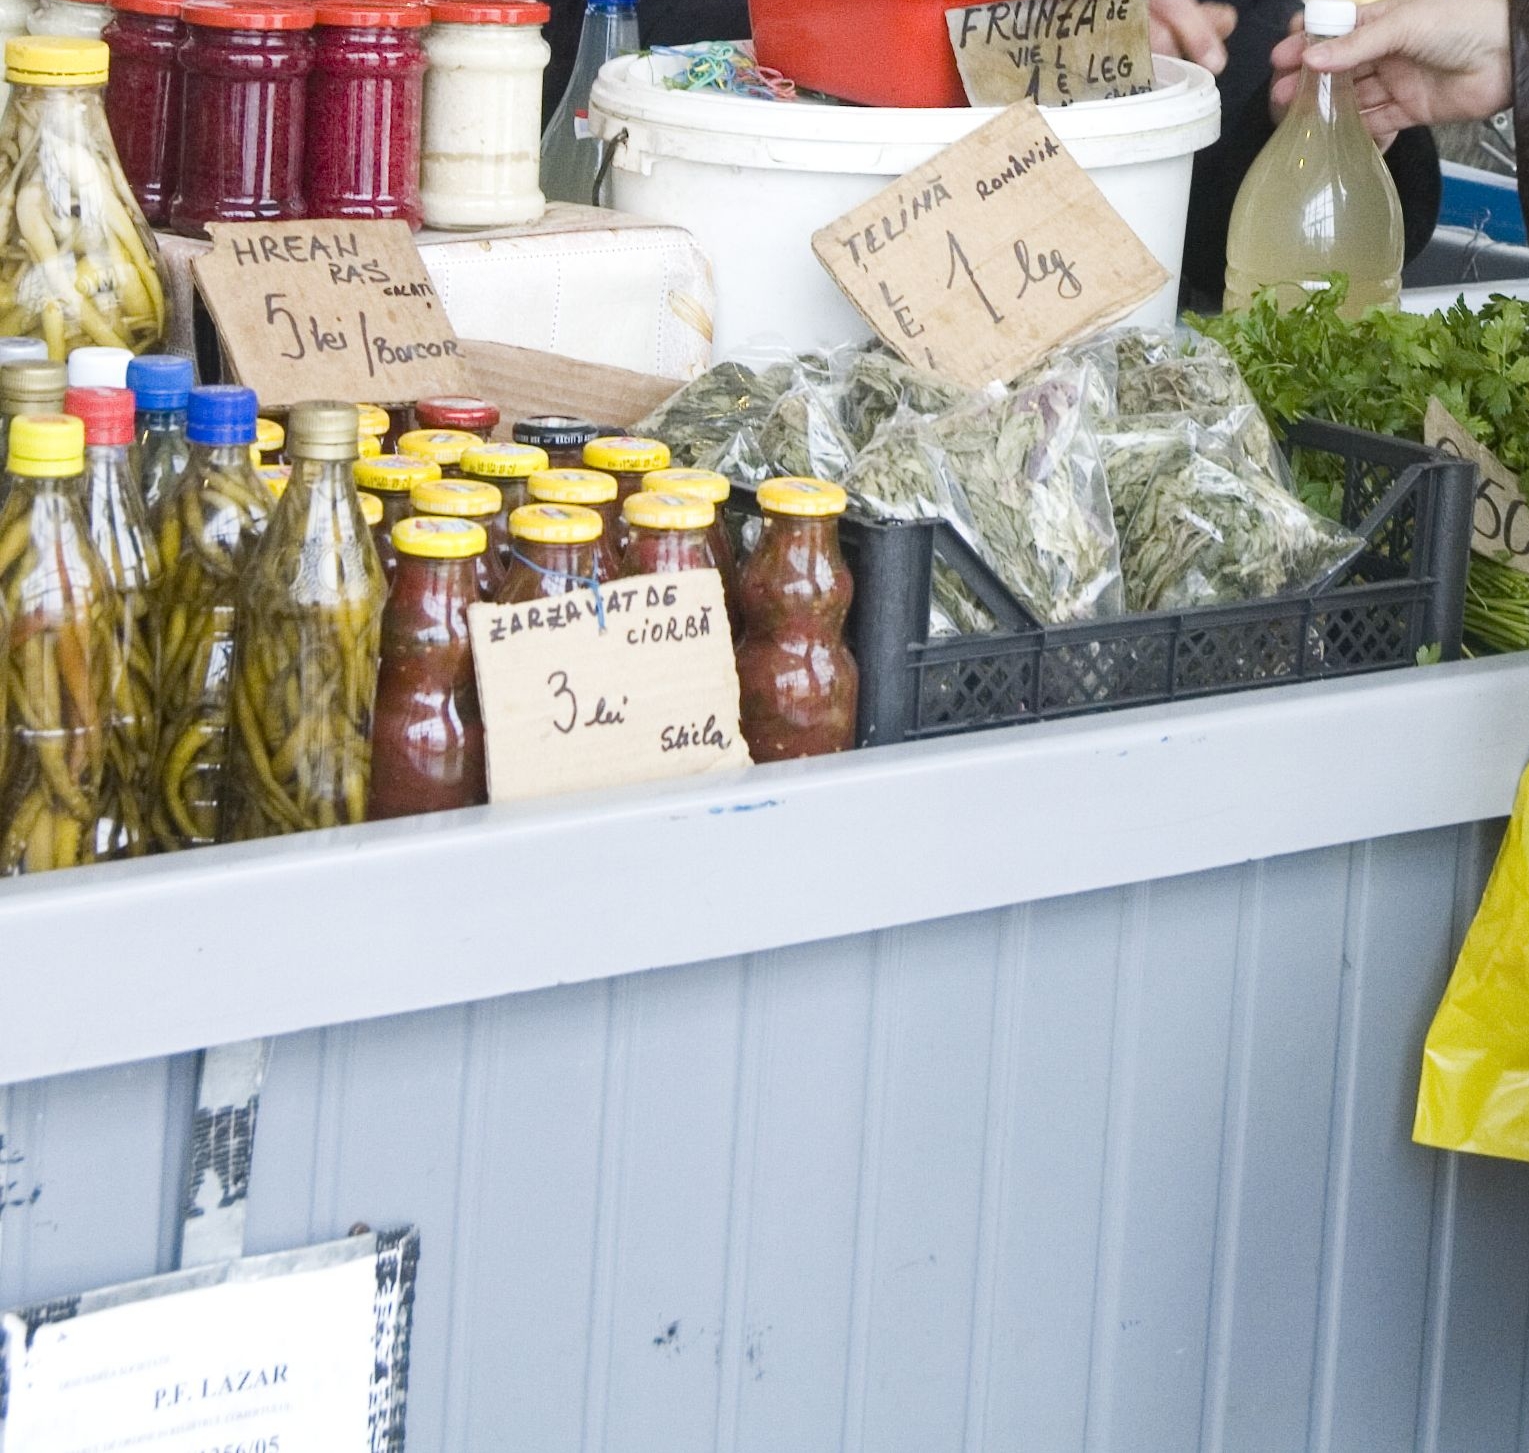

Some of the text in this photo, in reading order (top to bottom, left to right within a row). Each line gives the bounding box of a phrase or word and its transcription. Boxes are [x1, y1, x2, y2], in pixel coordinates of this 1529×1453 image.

[1087, 53, 1133, 84] LEG
[231, 233, 359, 266] HREAN
[328, 259, 391, 285] RAS
[946, 230, 1082, 324] 1 leg
[265, 294, 306, 359] 5
[646, 585, 678, 607] DE
[547, 671, 628, 734] 3 lei
[153, 1380, 193, 1410] P.F.
[200, 1362, 289, 1400] LAZAR
